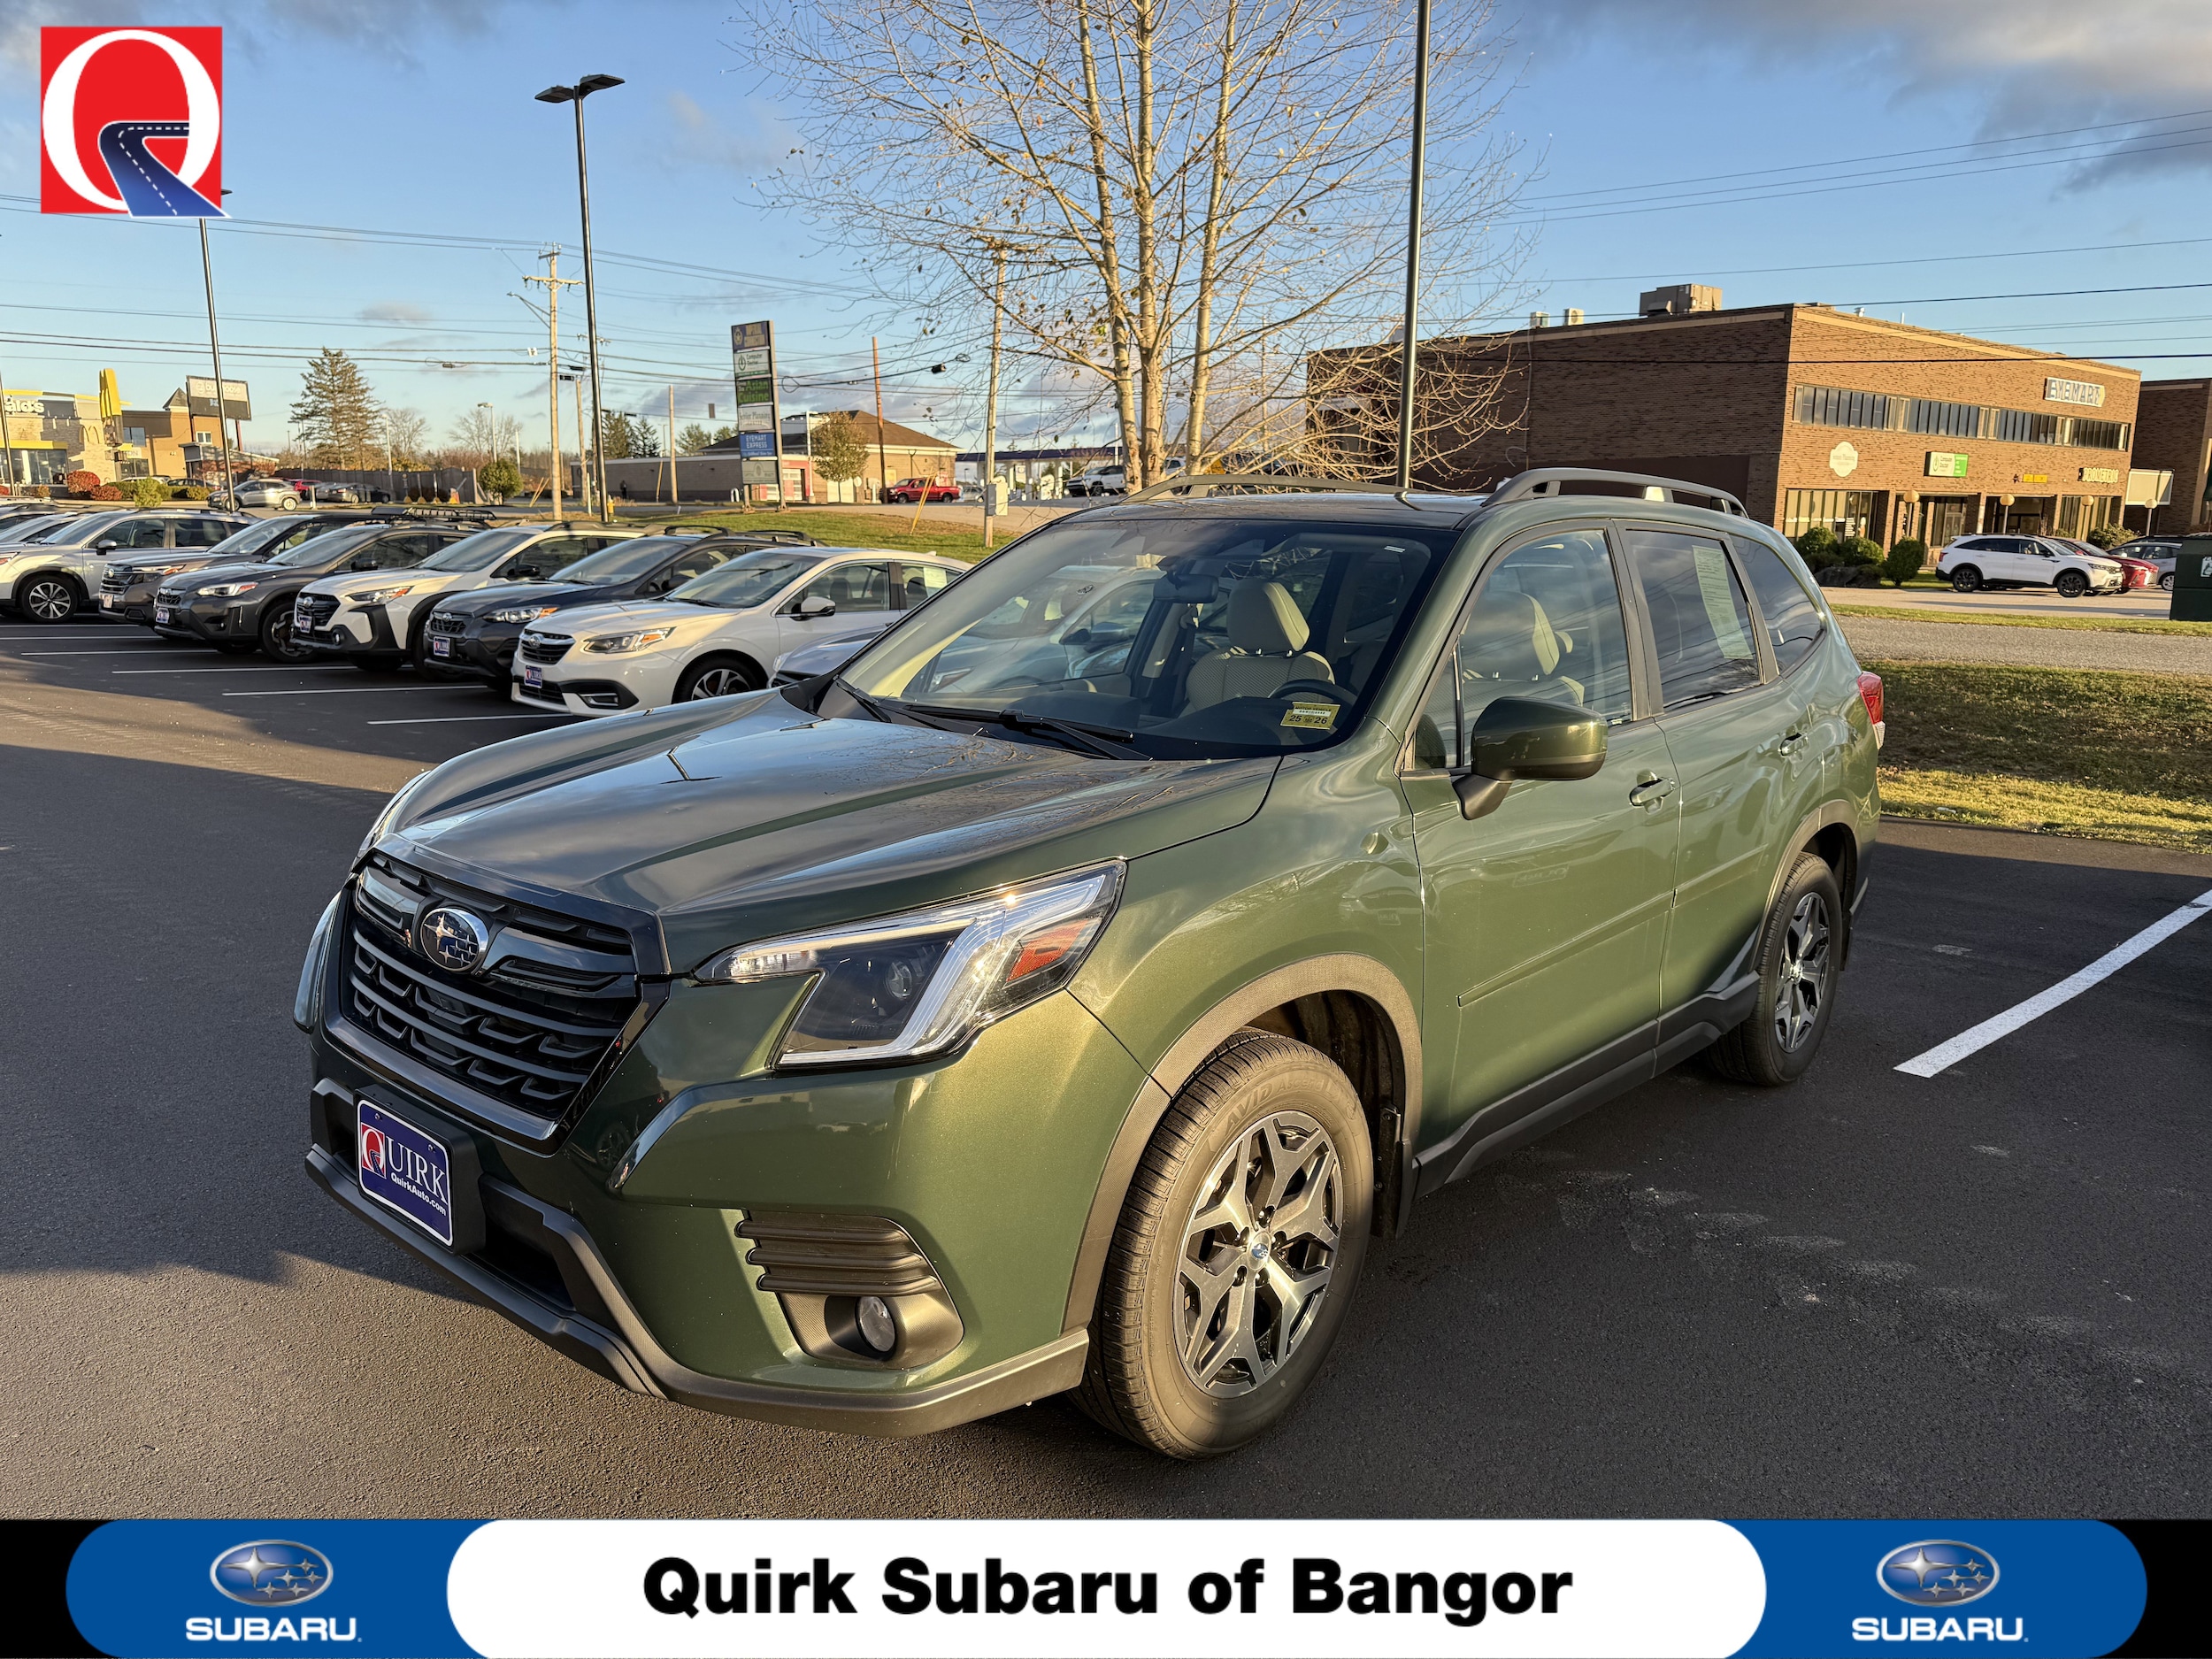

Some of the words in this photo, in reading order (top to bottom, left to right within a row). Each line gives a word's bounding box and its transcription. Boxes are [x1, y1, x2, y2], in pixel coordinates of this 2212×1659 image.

[746, 380, 770, 391] Asian
[738, 392, 770, 403] Cuisine
[390, 1172, 447, 1217] QuirkAuto.com
